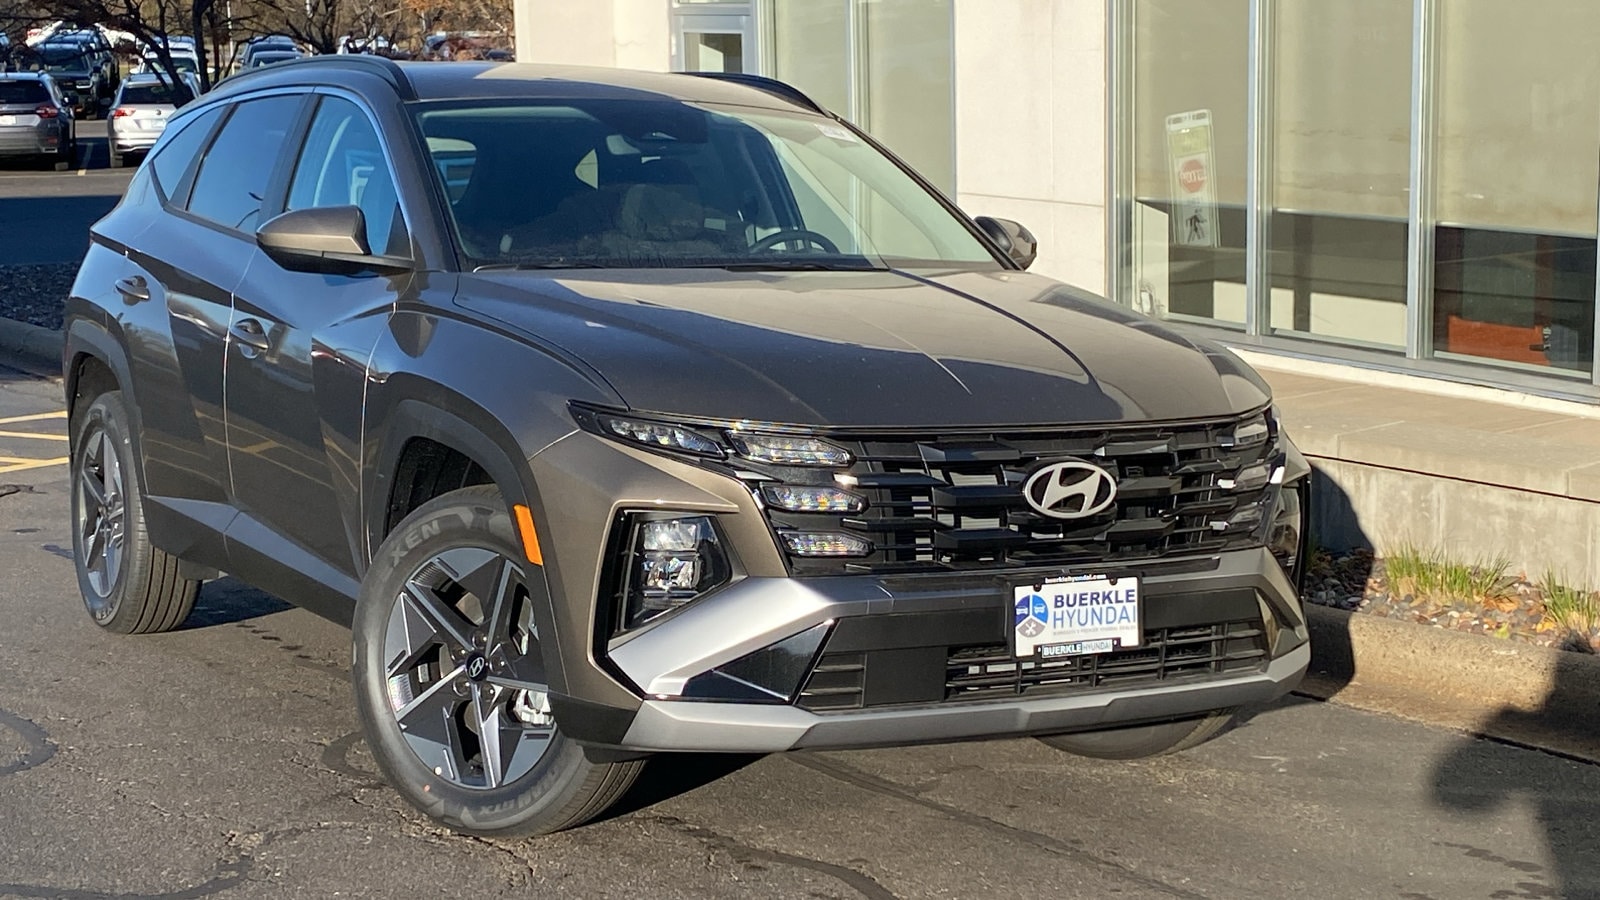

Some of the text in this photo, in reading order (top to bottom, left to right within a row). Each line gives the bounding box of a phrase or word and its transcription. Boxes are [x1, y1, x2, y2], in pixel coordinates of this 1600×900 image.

[1053, 589, 1136, 608] BUERKLE
[1053, 605, 1136, 629] HYUNDAI
[1043, 640, 1111, 656] BUERKLE HYUNDAI
